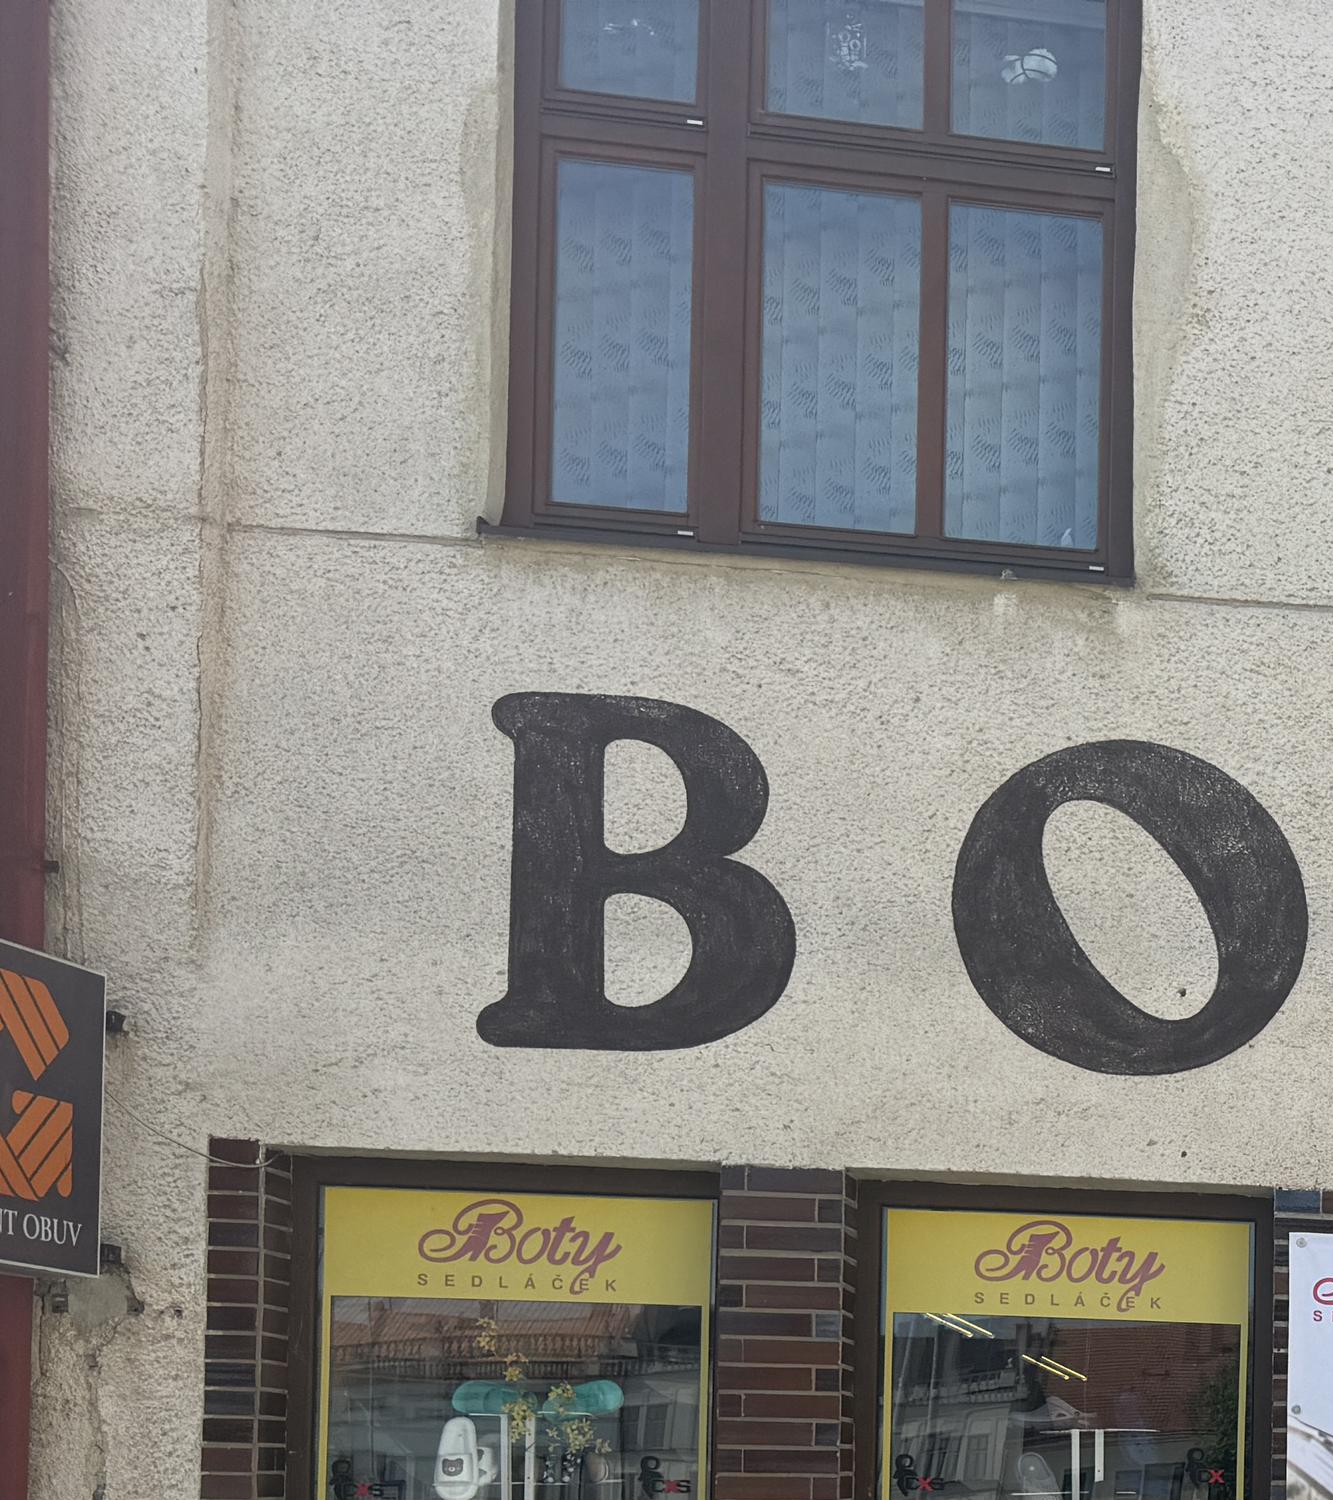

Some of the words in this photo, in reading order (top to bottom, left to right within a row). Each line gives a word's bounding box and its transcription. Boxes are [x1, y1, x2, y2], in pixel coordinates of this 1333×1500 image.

[23, 1213, 82, 1247] OBUV
[417, 1198, 622, 1295] Boty
[417, 1271, 617, 1293] SEDLÁČEK
[974, 1220, 1165, 1312] Boty
[974, 1291, 1162, 1310] SEDLÁČEK
